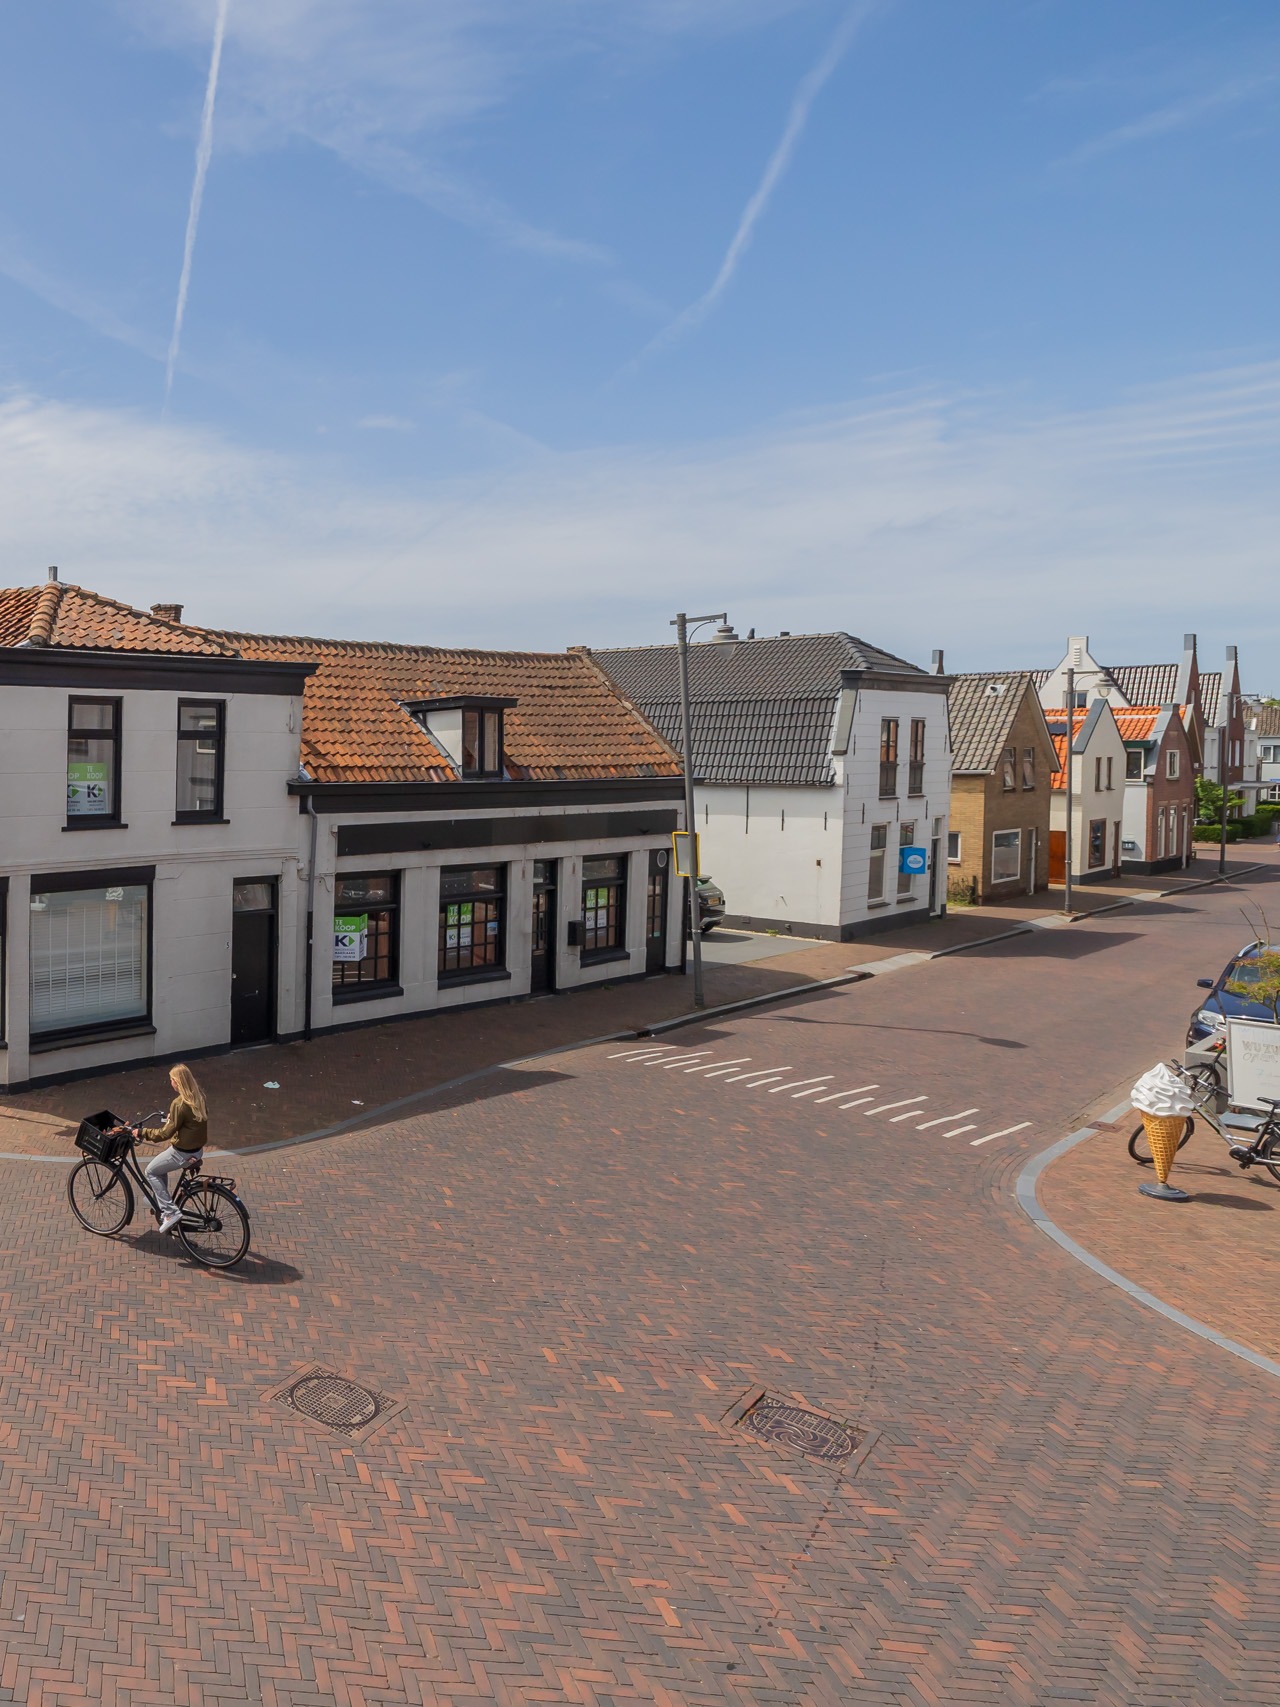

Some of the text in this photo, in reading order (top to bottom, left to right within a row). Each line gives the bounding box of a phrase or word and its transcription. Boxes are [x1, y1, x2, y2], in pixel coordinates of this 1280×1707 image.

[87, 765, 94, 773] TE
[86, 772, 104, 780] KOOP
[450, 906, 459, 916] TE
